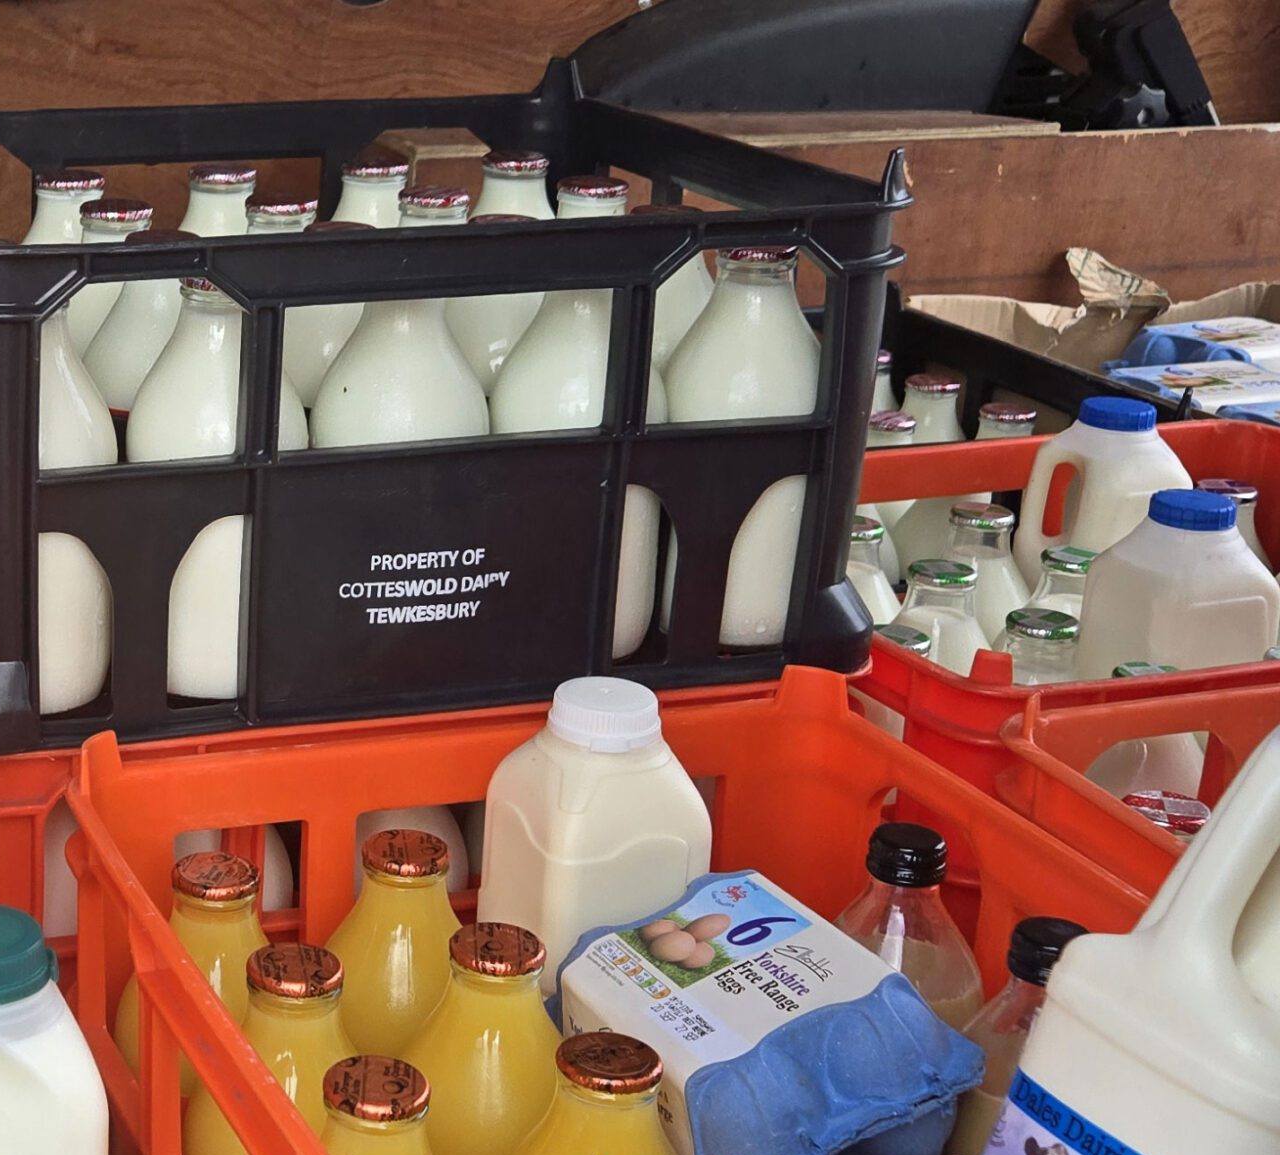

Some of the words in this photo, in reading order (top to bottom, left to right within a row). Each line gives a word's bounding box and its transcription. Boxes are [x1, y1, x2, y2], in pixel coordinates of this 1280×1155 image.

[370, 550, 459, 571] PROPERTY
[461, 548, 485, 566] OF
[339, 577, 458, 599] COTTESWOLD
[366, 600, 481, 624] TEWKESBURY
[726, 916, 797, 946] 6
[714, 969, 747, 997] Eggs
[732, 959, 764, 986] Free
[758, 981, 800, 1013] Range
[752, 951, 811, 998] Yorkshire
[1011, 1079, 1061, 1128] Dales
